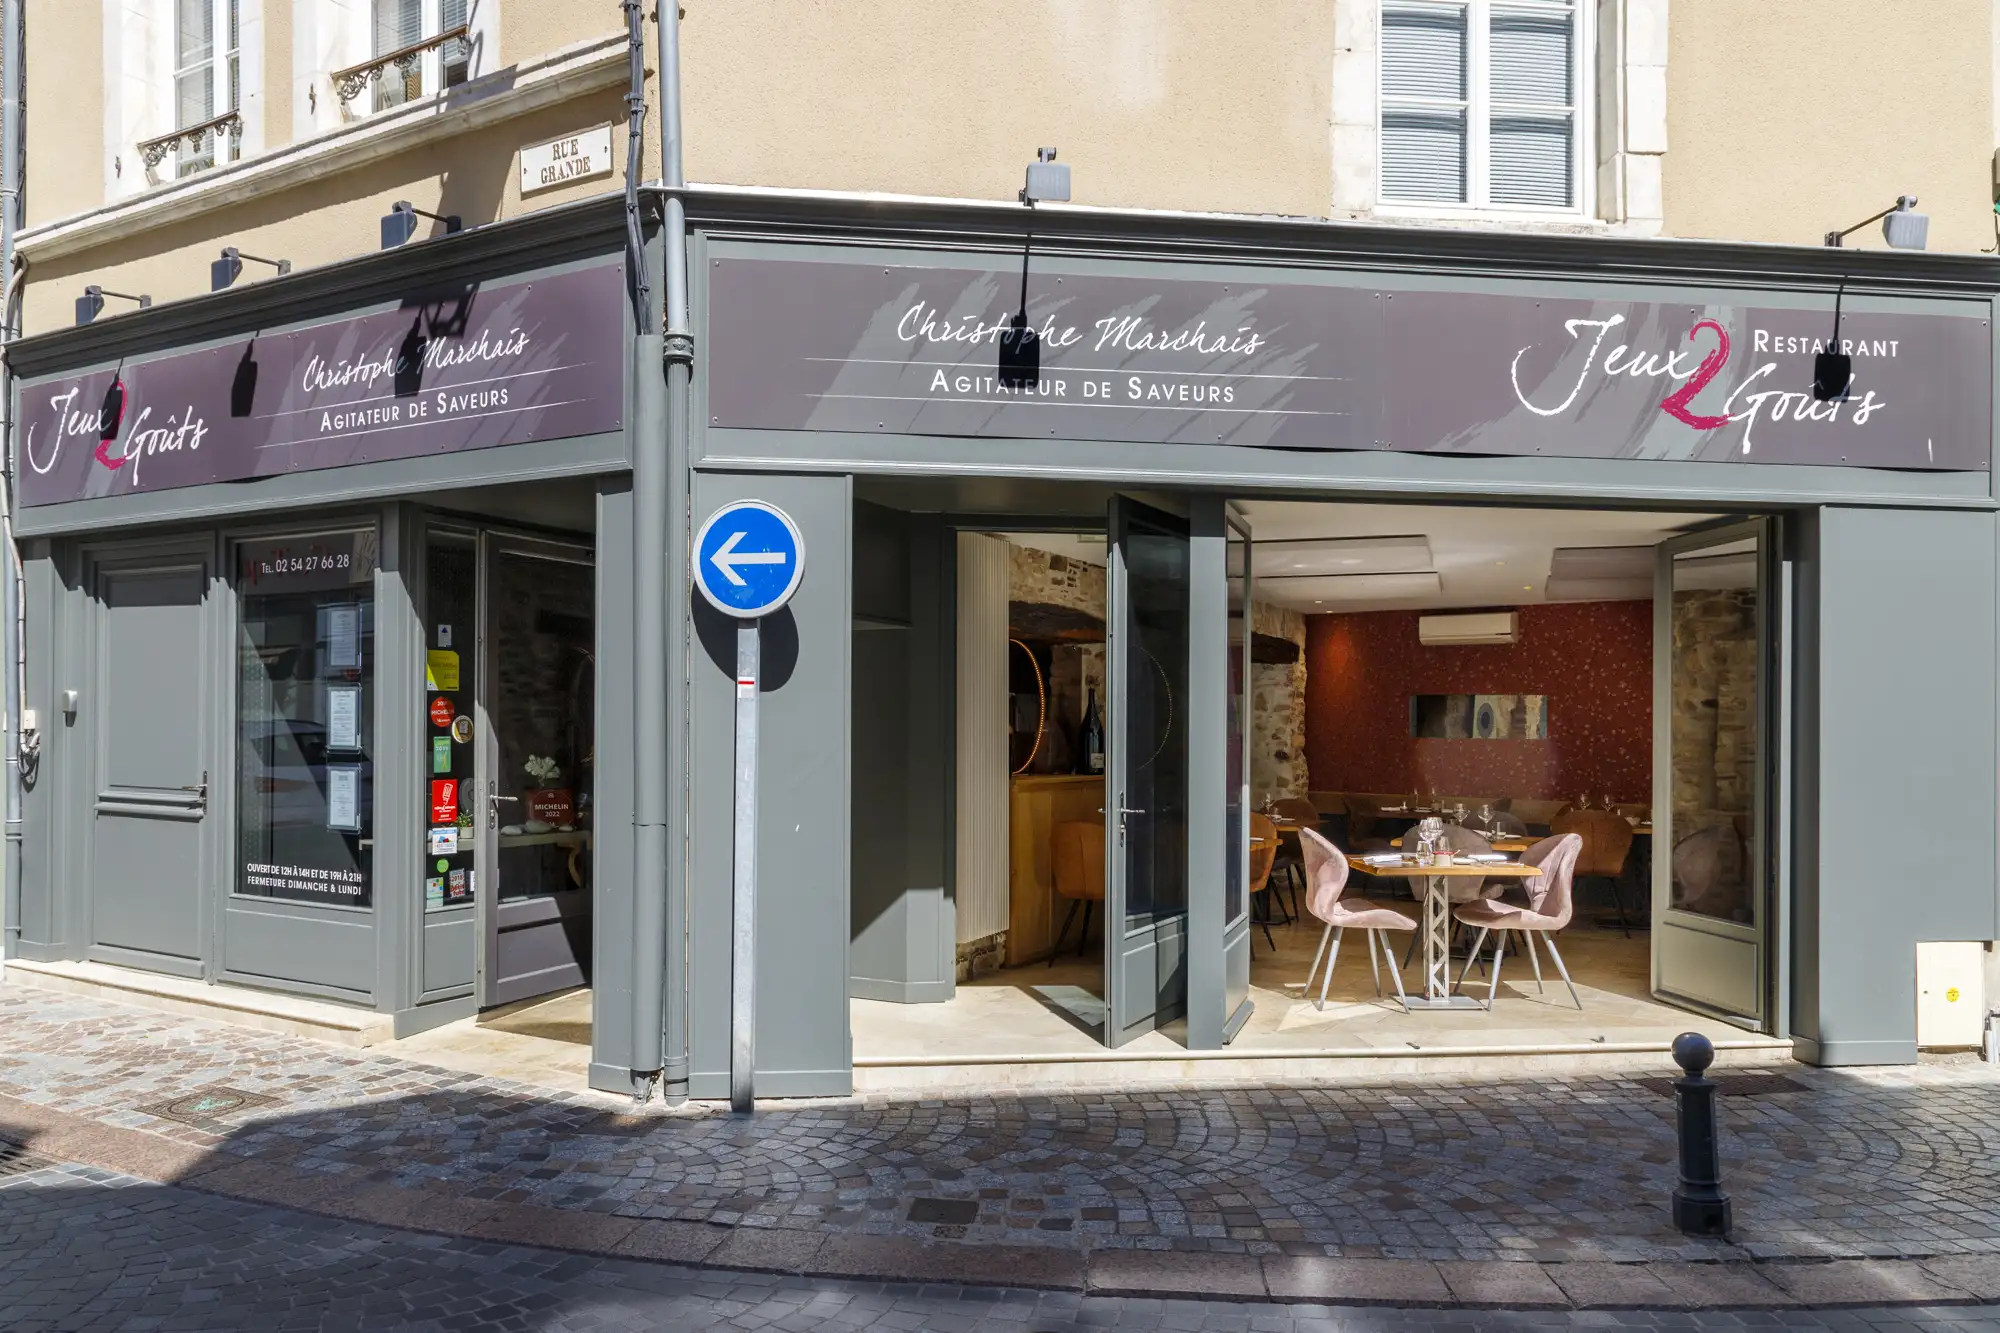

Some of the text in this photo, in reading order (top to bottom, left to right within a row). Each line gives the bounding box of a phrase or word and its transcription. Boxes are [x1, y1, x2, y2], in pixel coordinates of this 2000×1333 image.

[552, 138, 579, 161] RUE
[540, 156, 591, 185] GRANDE
[898, 300, 1266, 355] Christophe Marchais
[302, 326, 531, 393] Christophe Marchais
[1511, 313, 1735, 430] Jeux 2
[1083, 380, 1112, 399] DE
[408, 401, 428, 419] DE
[1722, 362, 1887, 455] Goûts
[27, 386, 114, 475] Jeux
[123, 404, 209, 486] Goûts
[275, 559, 288, 573] 02
[290, 558, 303, 572] 54
[305, 556, 318, 571] 27
[321, 555, 334, 570] 66
[336, 554, 350, 568] 28
[534, 803, 569, 811] MICHELIN
[246, 863, 362, 883] OUVERT DE 12H À 14H ET DE 19H À 21H
[247, 875, 361, 895] FERMETURE DIMANCHE & LUNDI
